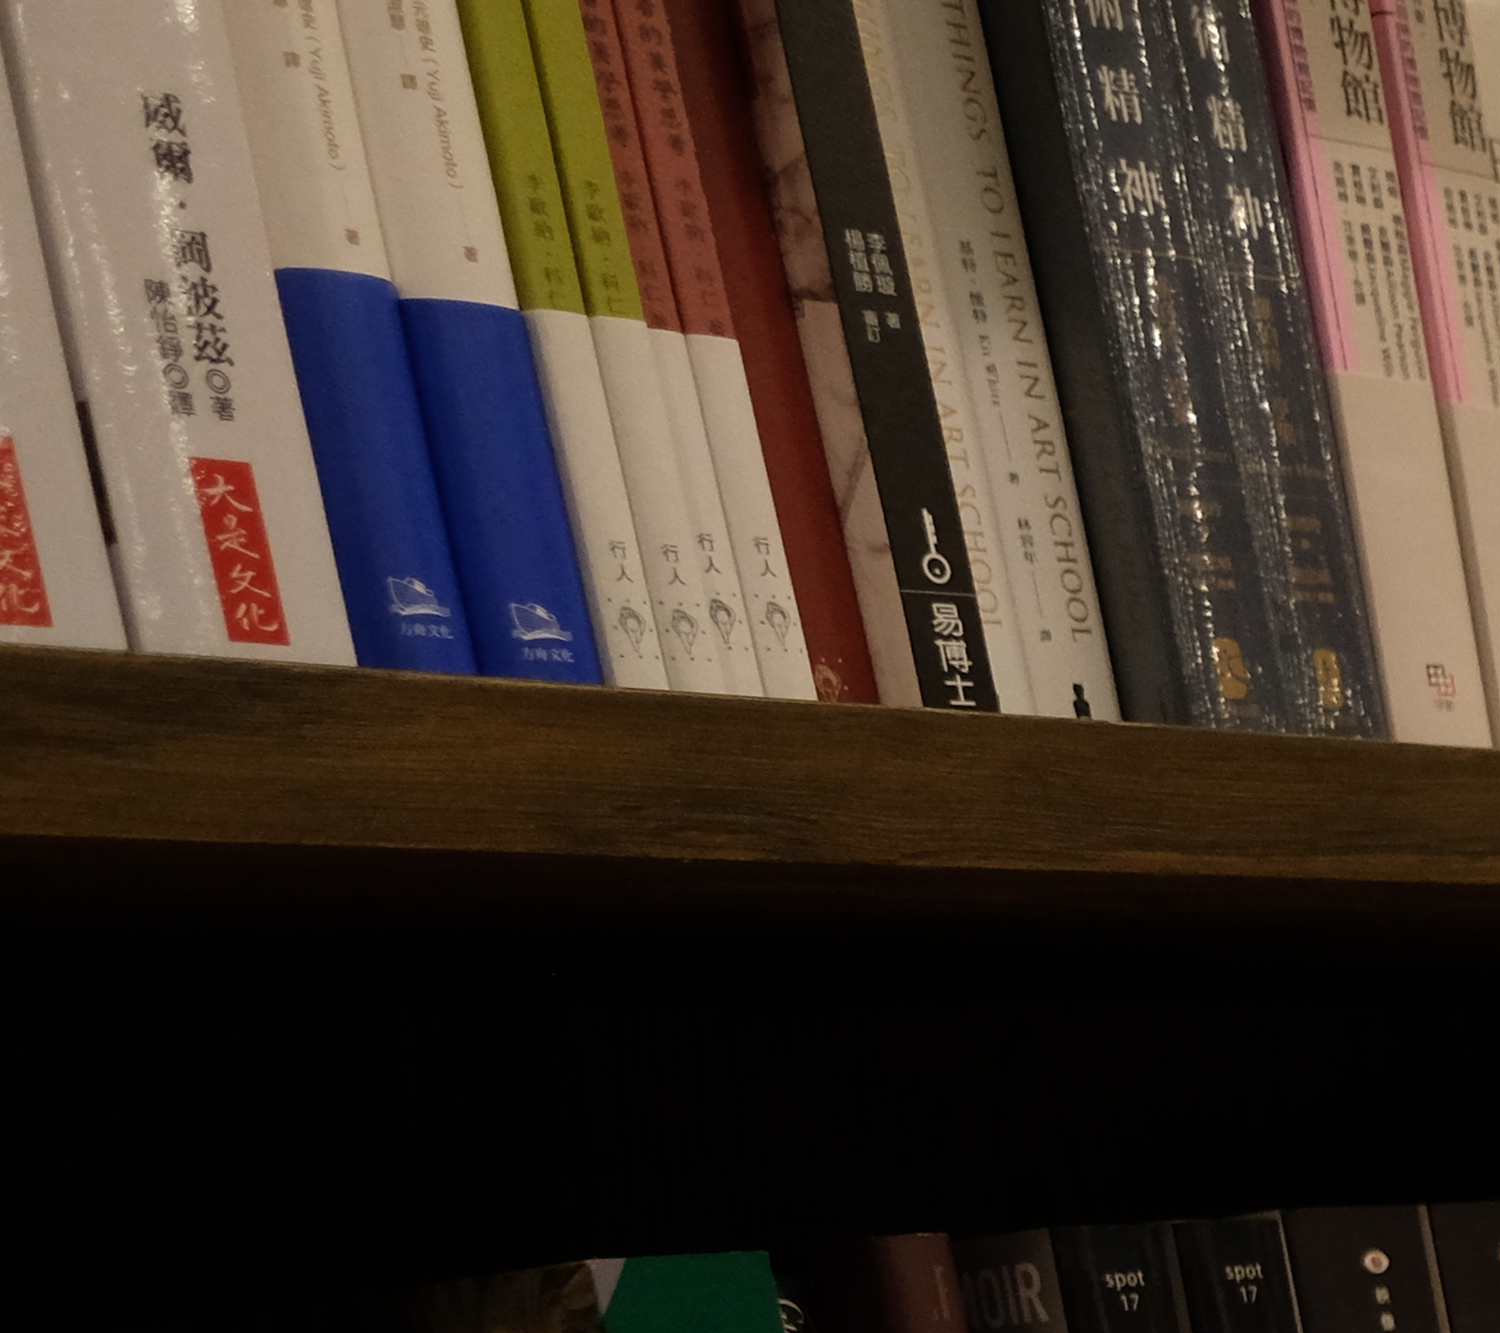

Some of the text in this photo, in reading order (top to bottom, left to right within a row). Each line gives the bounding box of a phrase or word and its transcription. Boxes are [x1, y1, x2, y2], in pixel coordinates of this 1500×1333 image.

[975, 164, 1005, 216] TO
[988, 229, 1036, 346] LEARN
[1016, 357, 1048, 402] IN
[1028, 411, 1063, 483] ART
[200, 472, 281, 633] 大是文化
[608, 539, 635, 585] 行人
[661, 542, 687, 588] 行人
[696, 531, 722, 577] 行人
[751, 534, 778, 580] 行人
[1044, 493, 1094, 645] SCHOOL
[931, 602, 977, 707] 易博士
[1103, 1266, 1146, 1295] spot
[1224, 1259, 1265, 1287] spot
[1238, 1286, 1258, 1305] 17
[1119, 1294, 1140, 1313] 17
